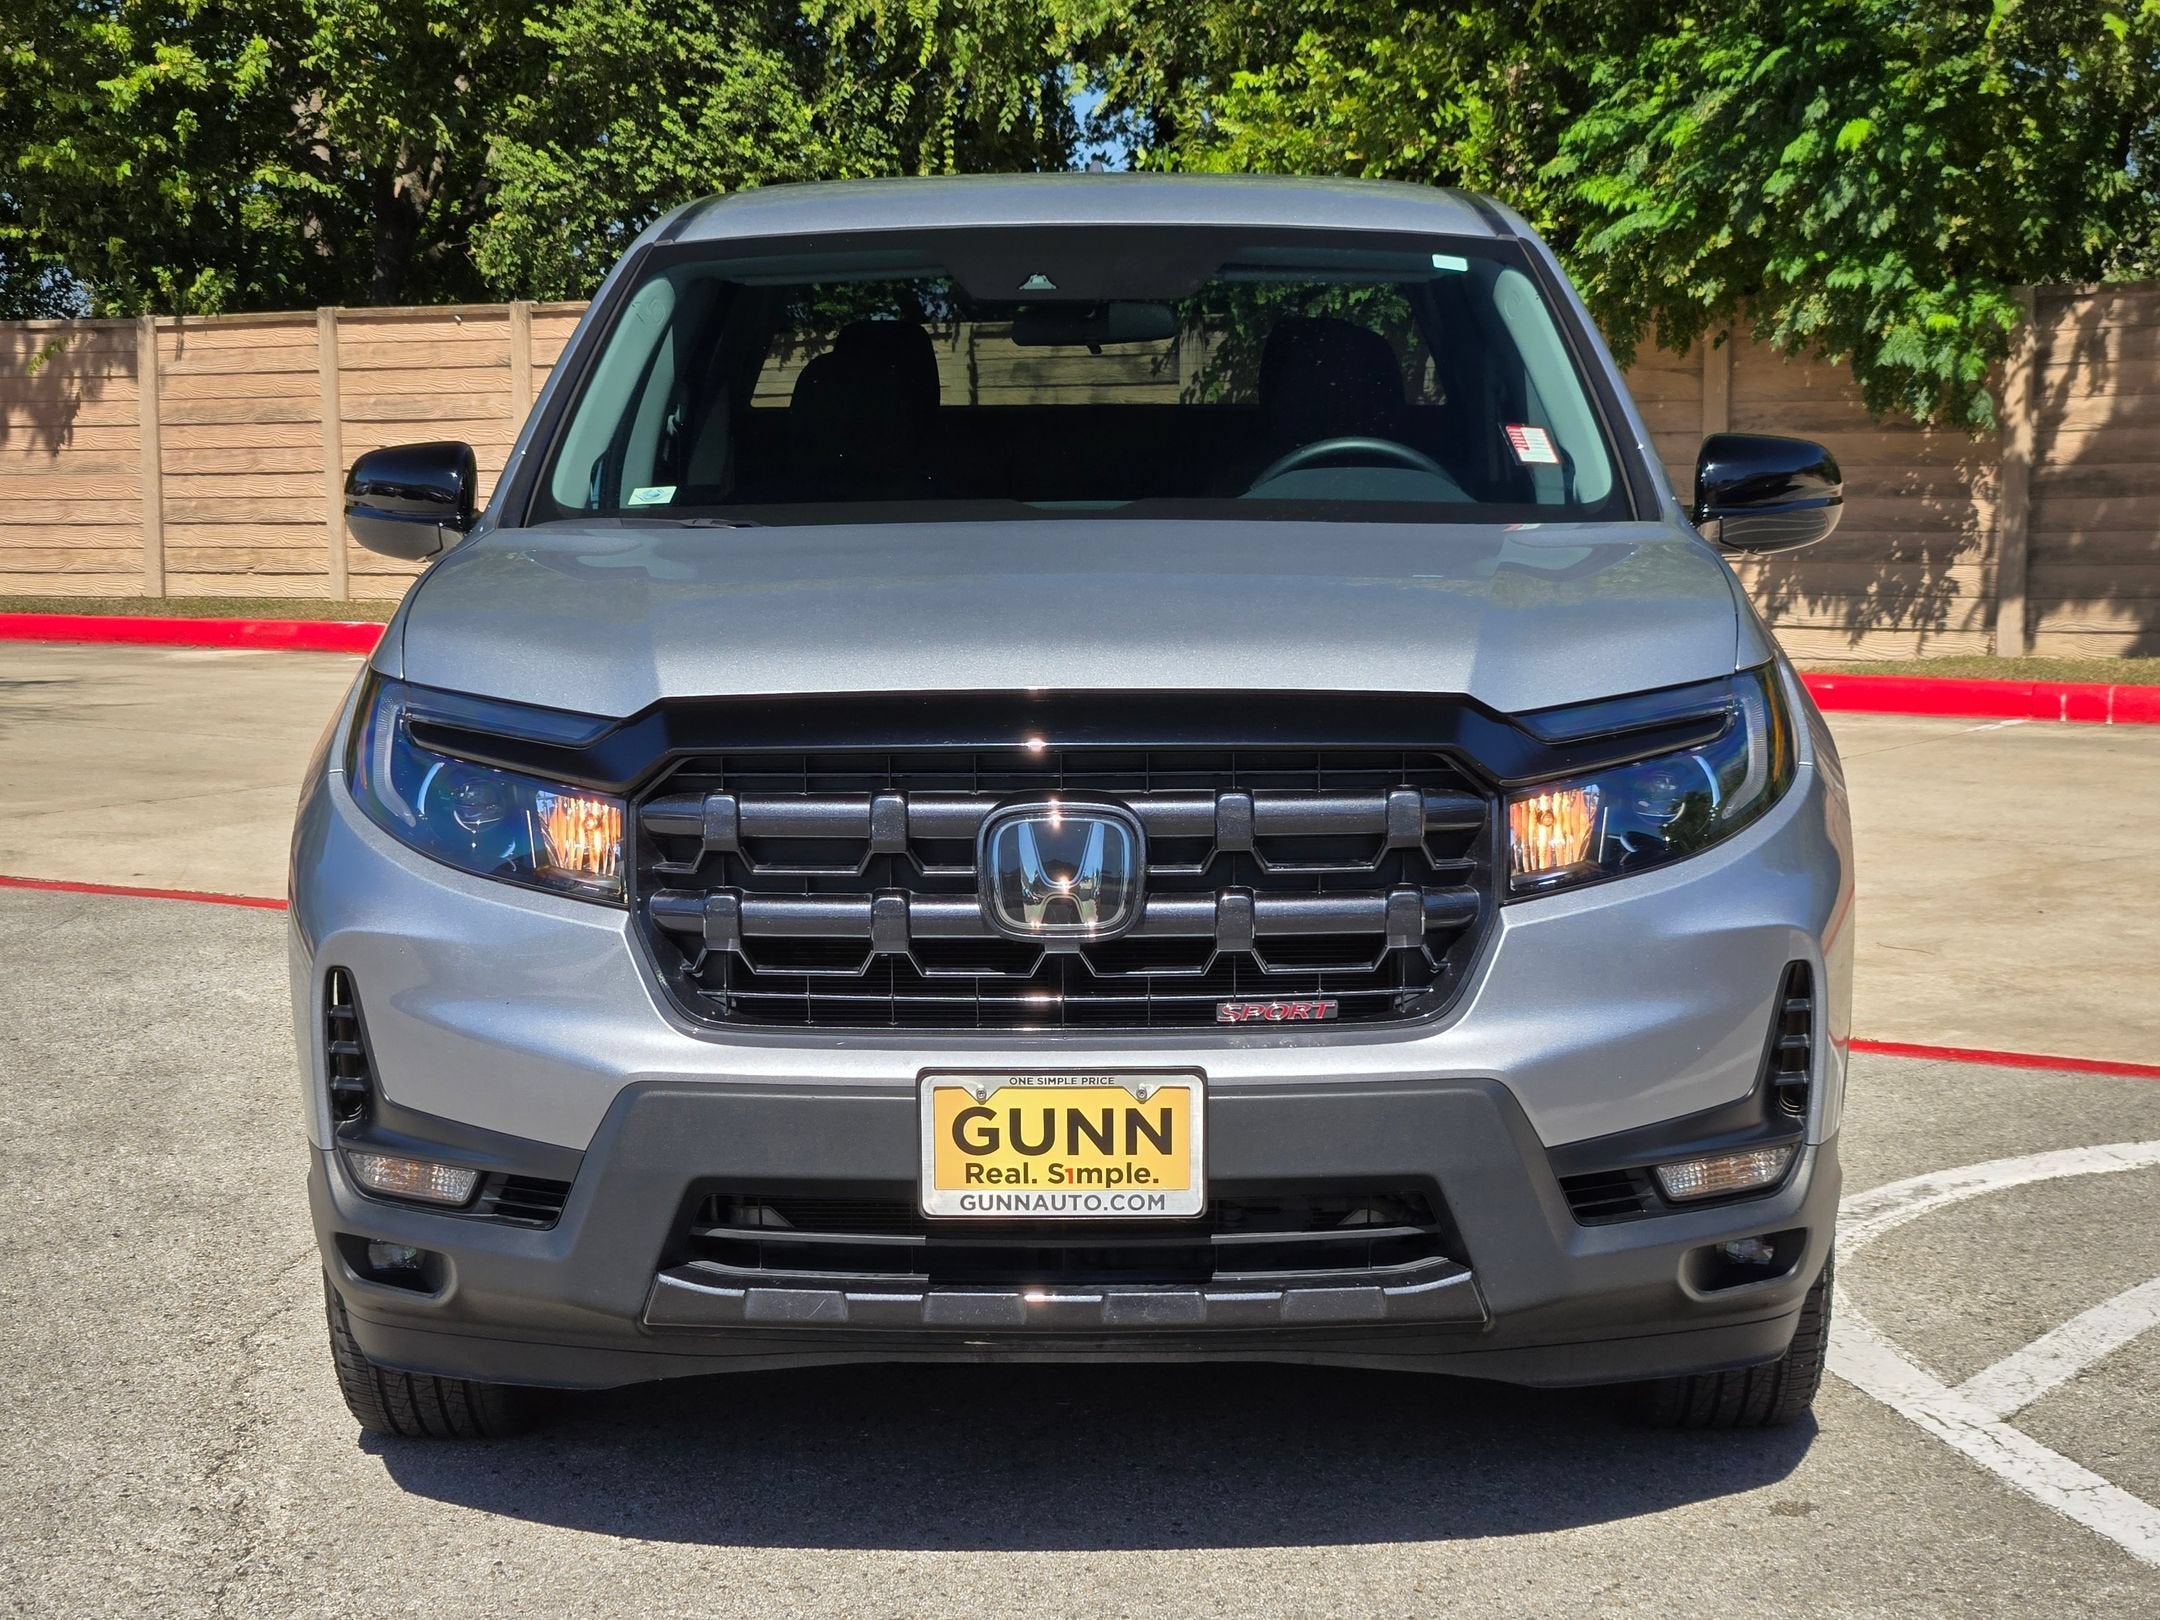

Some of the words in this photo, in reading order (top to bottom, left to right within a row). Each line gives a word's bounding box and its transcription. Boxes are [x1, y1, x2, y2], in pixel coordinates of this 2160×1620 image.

[1218, 1001, 1336, 1022] SPORT
[1009, 1077, 1034, 1085] ONE
[1037, 1077, 1077, 1085] SIMPLE
[1081, 1077, 1115, 1085] PRICE
[952, 1106, 1173, 1156] GUNN
[965, 1163, 1037, 1184] Real.
[960, 1194, 1165, 1211] GUNNAUTO.COM
